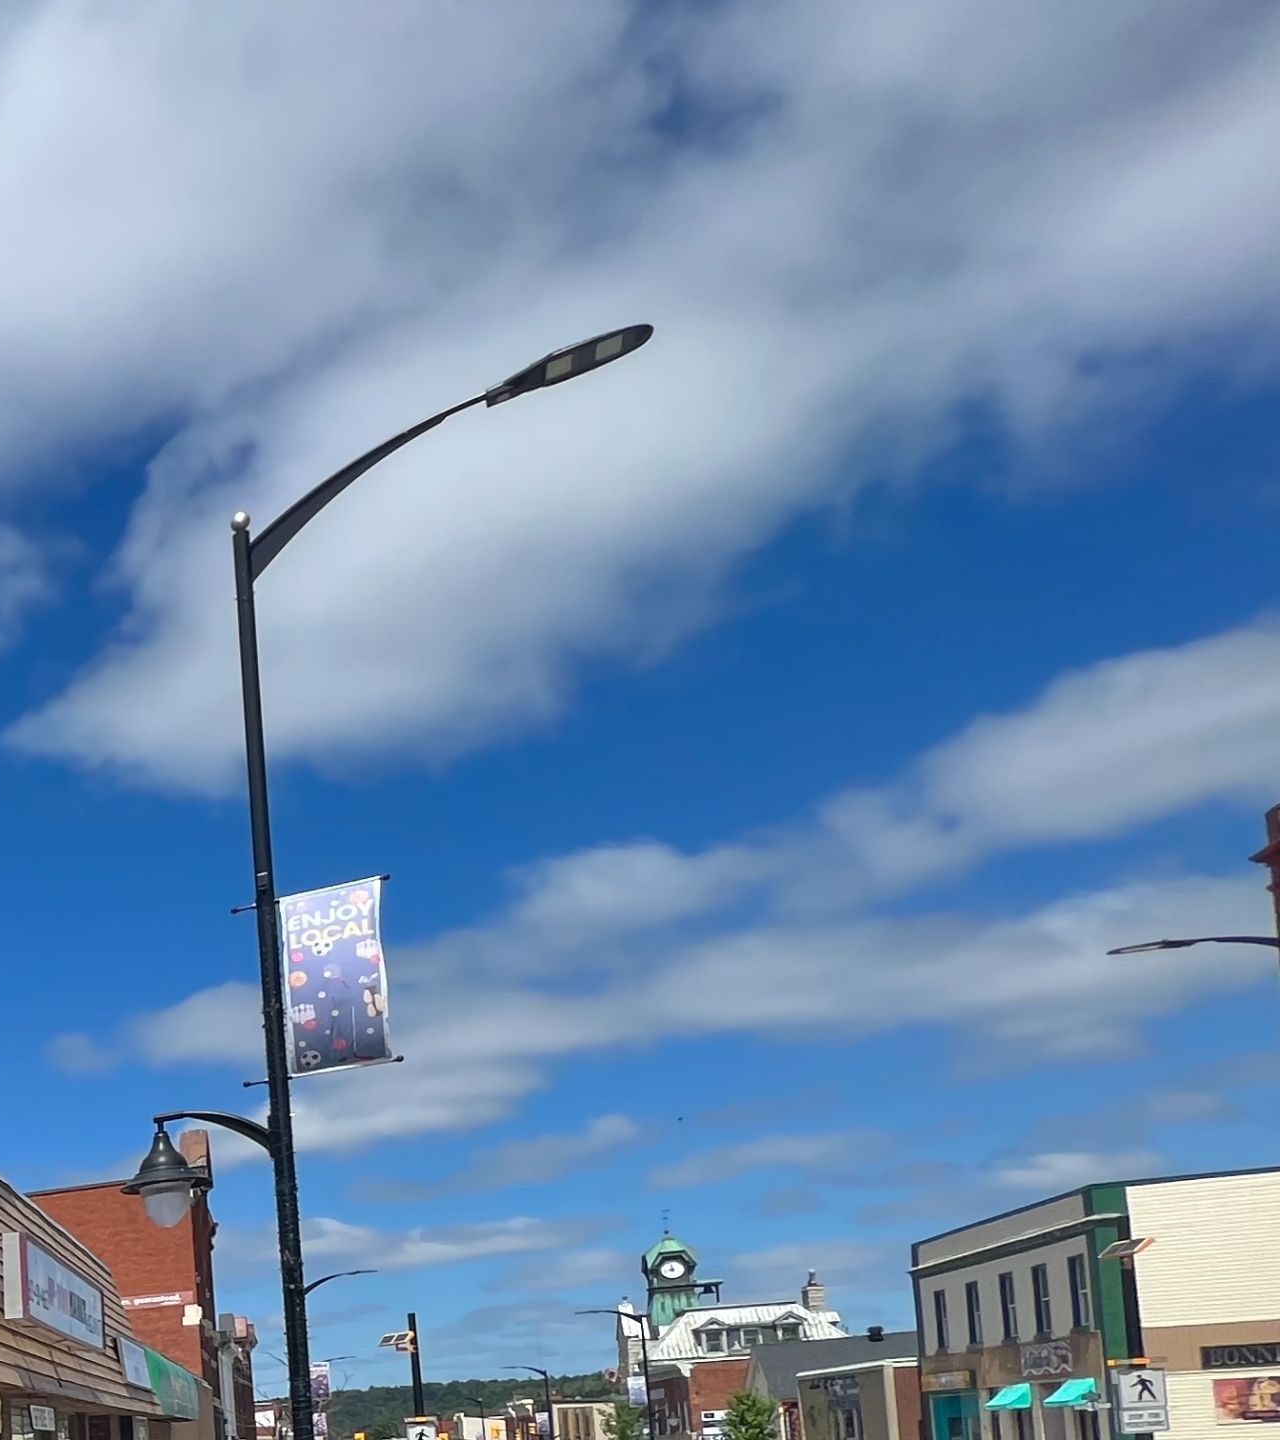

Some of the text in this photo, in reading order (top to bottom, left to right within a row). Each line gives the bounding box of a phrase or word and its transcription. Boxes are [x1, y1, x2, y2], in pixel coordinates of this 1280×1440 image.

[287, 899, 373, 932] ENJOY
[289, 919, 375, 950] LOCAL
[1210, 1345, 1280, 1366] BONN
